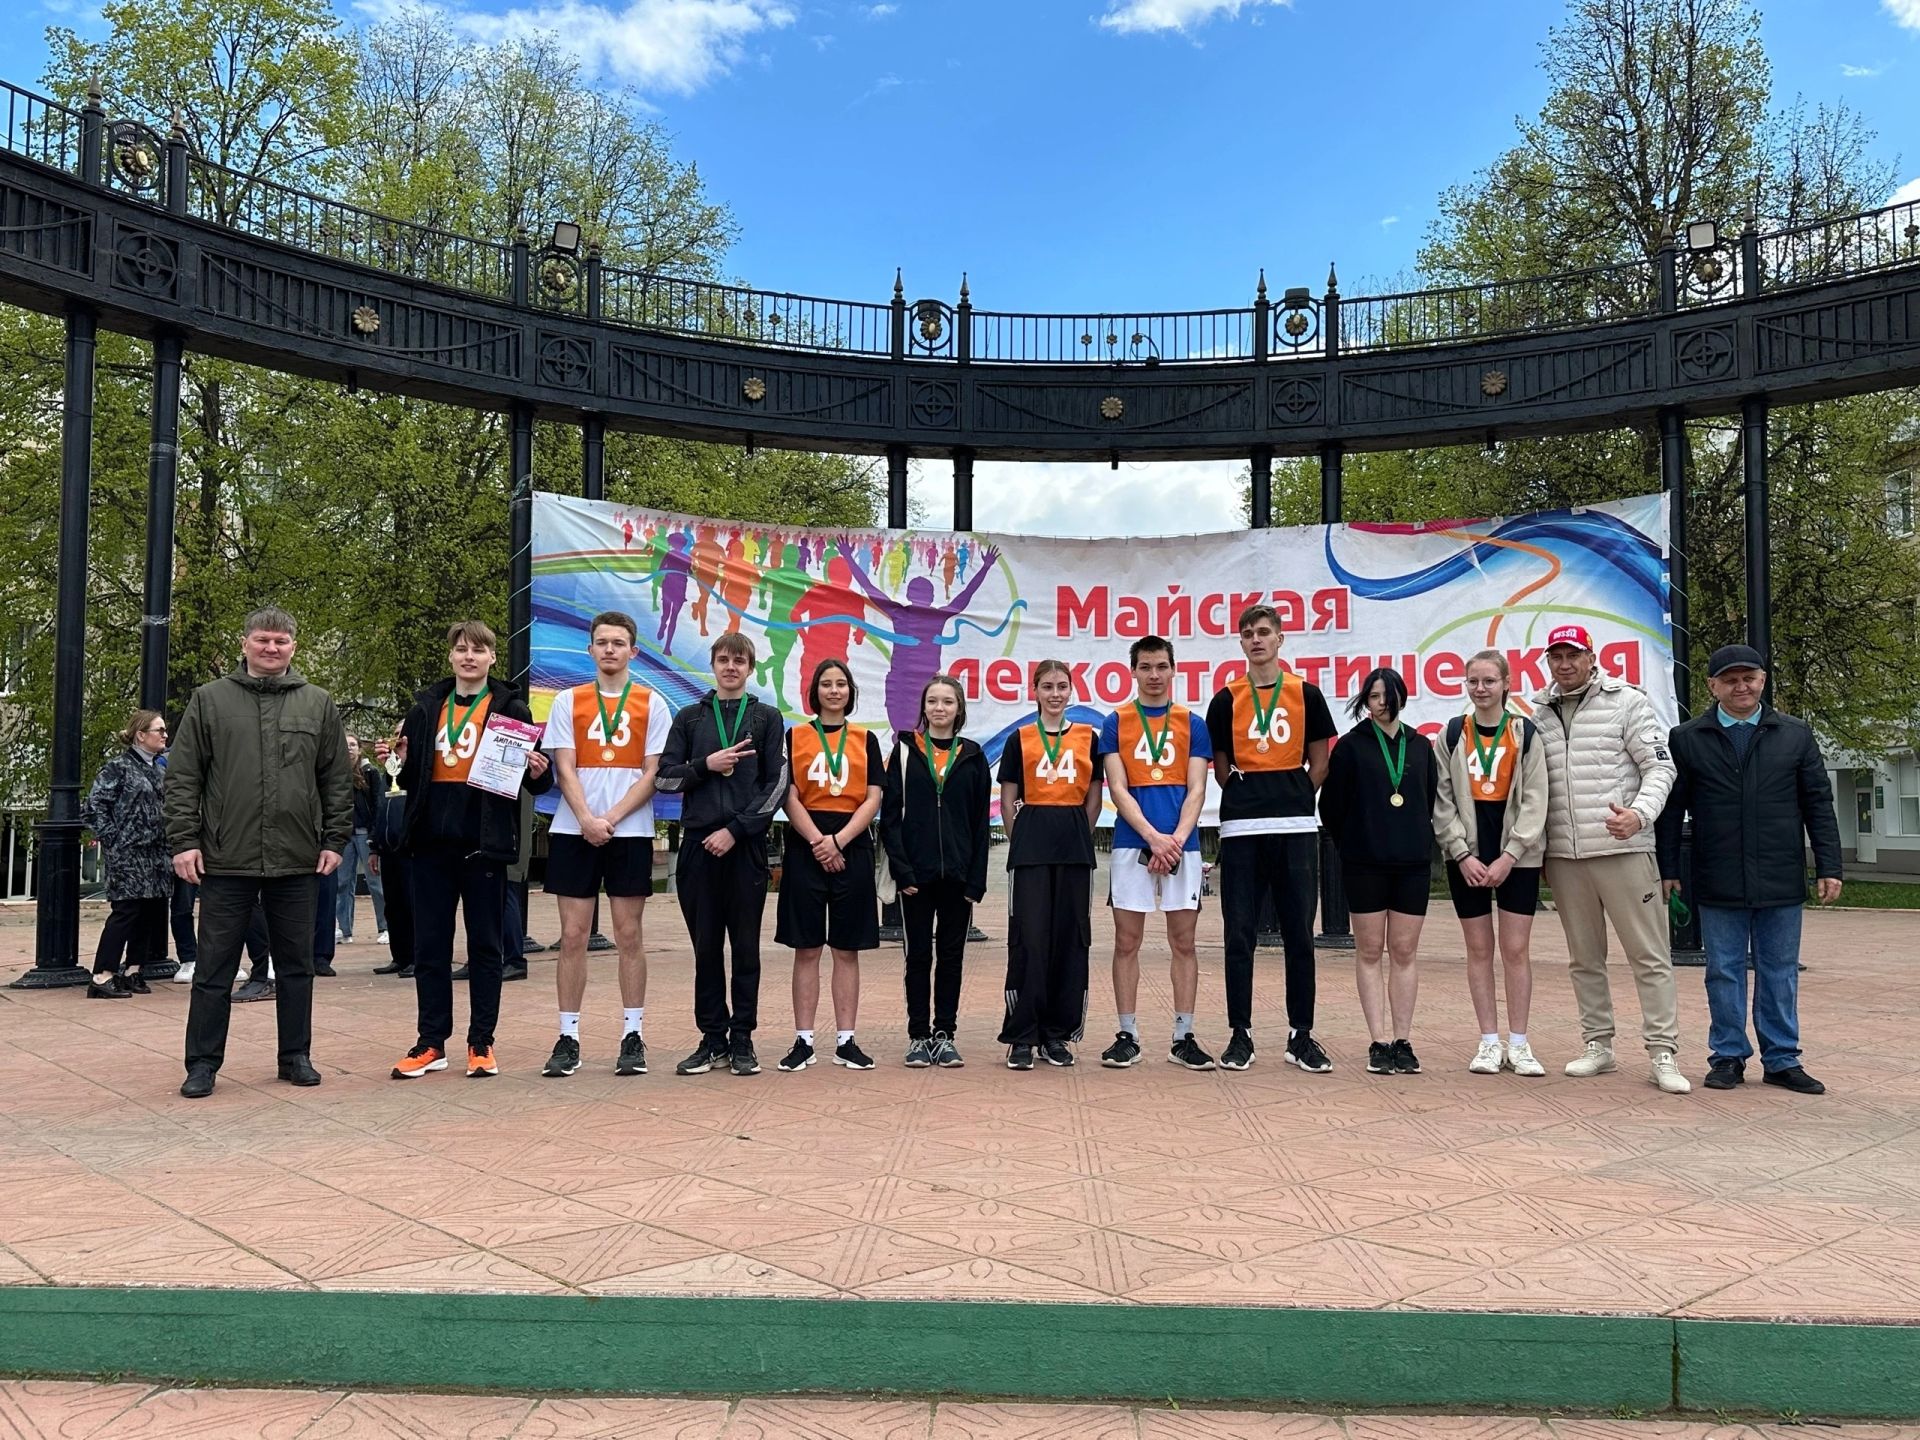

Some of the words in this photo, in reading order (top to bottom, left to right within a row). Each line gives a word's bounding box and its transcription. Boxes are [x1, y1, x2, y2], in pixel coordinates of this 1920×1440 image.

[1056, 584, 1349, 638] Майская
[435, 721, 478, 759] 49
[587, 710, 632, 748] 43
[1247, 707, 1291, 744] 46
[1036, 749, 1077, 784] 44
[1134, 731, 1176, 766] 45
[1466, 745, 1506, 782] 47
